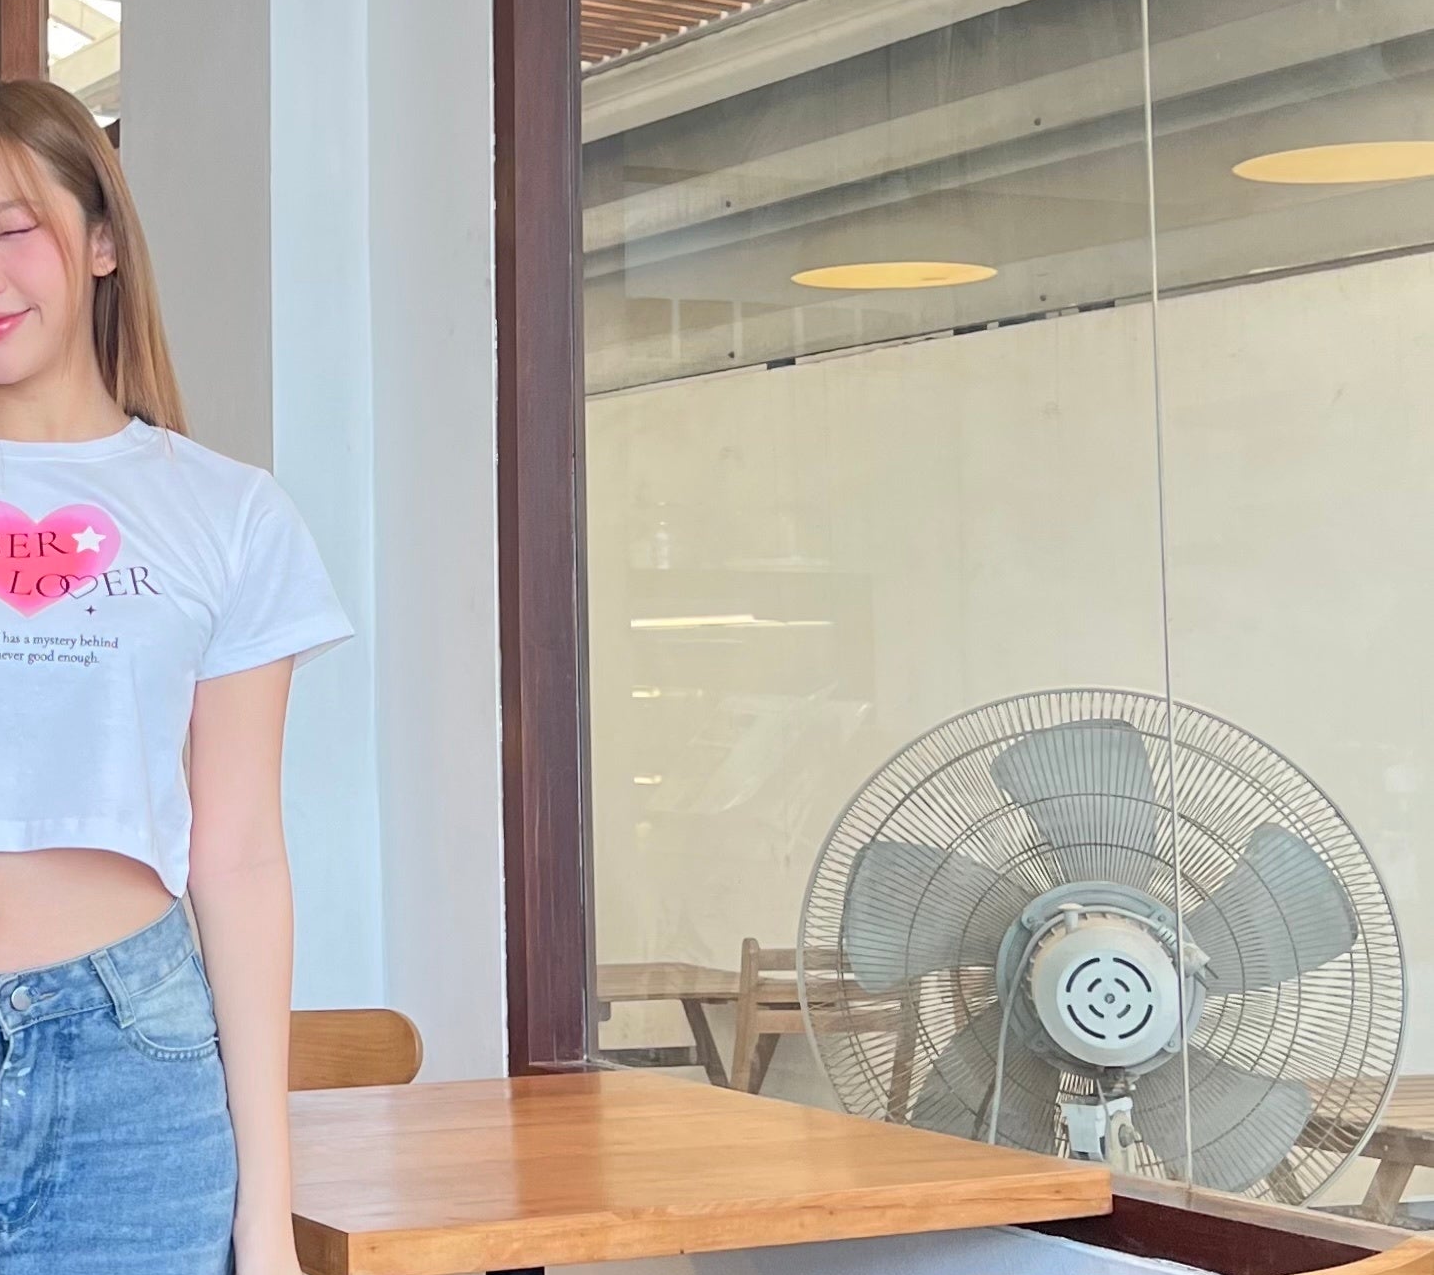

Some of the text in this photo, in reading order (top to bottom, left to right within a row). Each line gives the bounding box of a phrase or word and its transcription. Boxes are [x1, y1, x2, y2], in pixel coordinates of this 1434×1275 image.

[3, 631, 21, 644] has
[23, 636, 30, 644] a
[33, 636, 77, 650] mystery
[80, 633, 119, 649] behind
[27, 649, 55, 665] good
